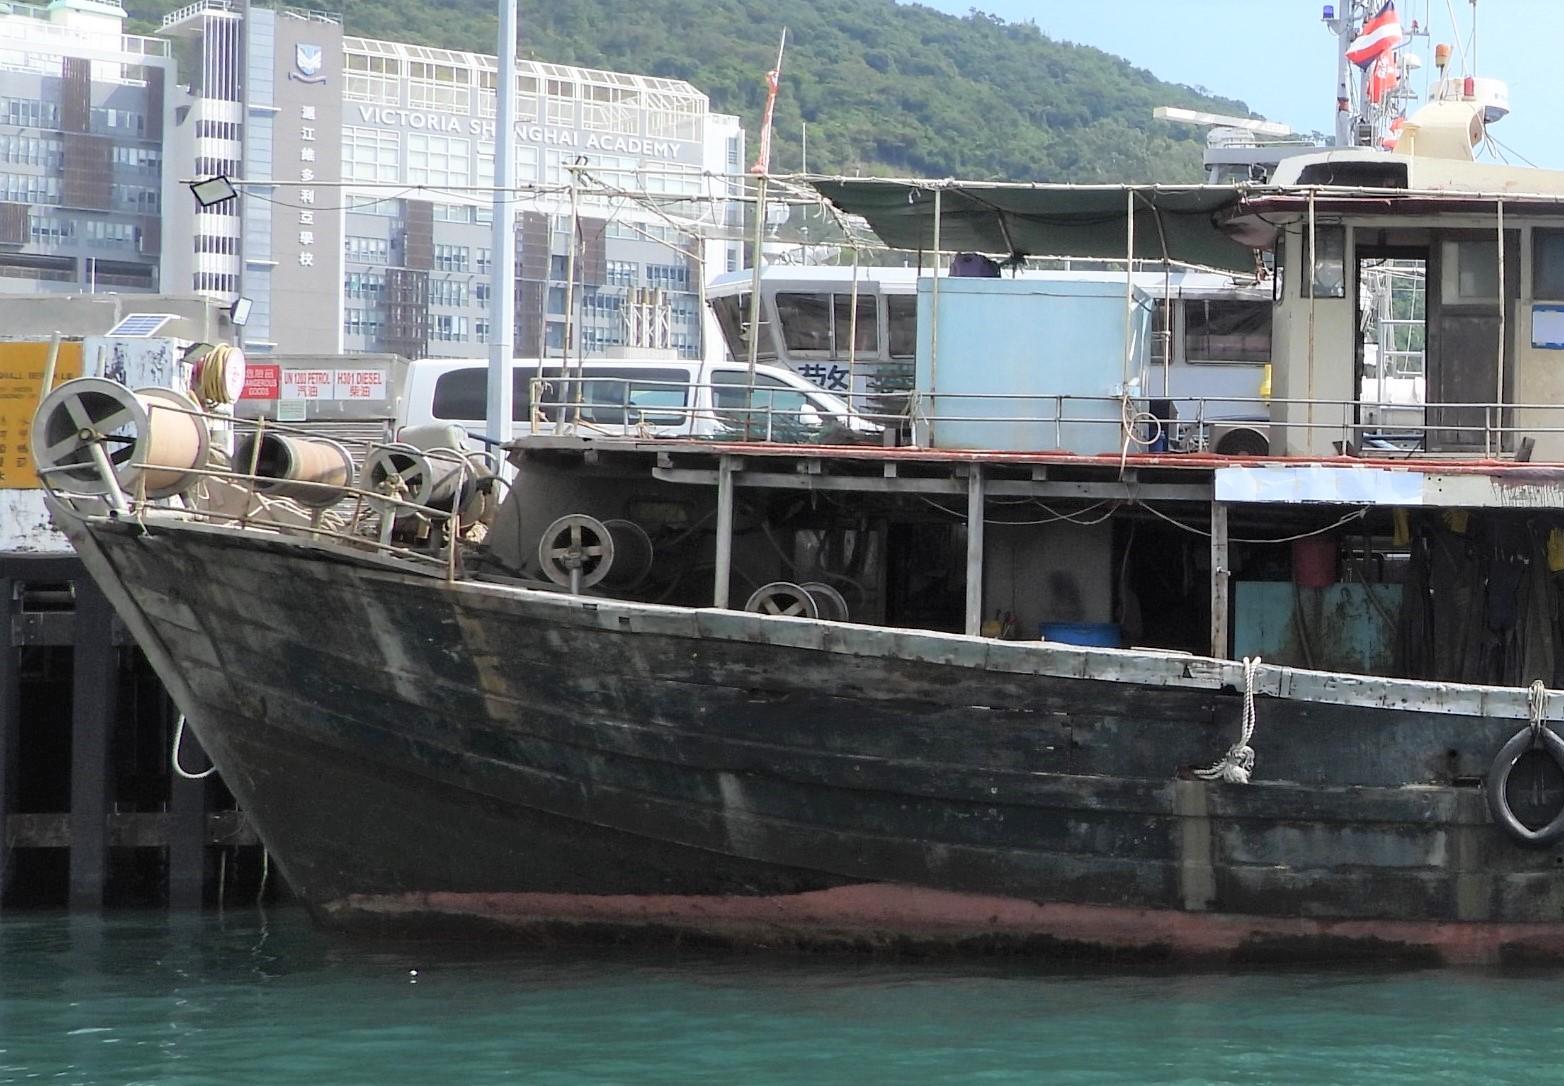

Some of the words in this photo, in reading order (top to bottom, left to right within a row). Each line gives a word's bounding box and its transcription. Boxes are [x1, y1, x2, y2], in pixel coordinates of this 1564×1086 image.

[359, 105, 461, 132] VICTORIA
[469, 119, 578, 146] SHNGHAI
[585, 134, 680, 158] ACADEMY
[307, 372, 330, 384] PETROL
[356, 372, 382, 384] DIESEL
[297, 385, 318, 397] 汽油
[350, 385, 371, 397] 柴油
